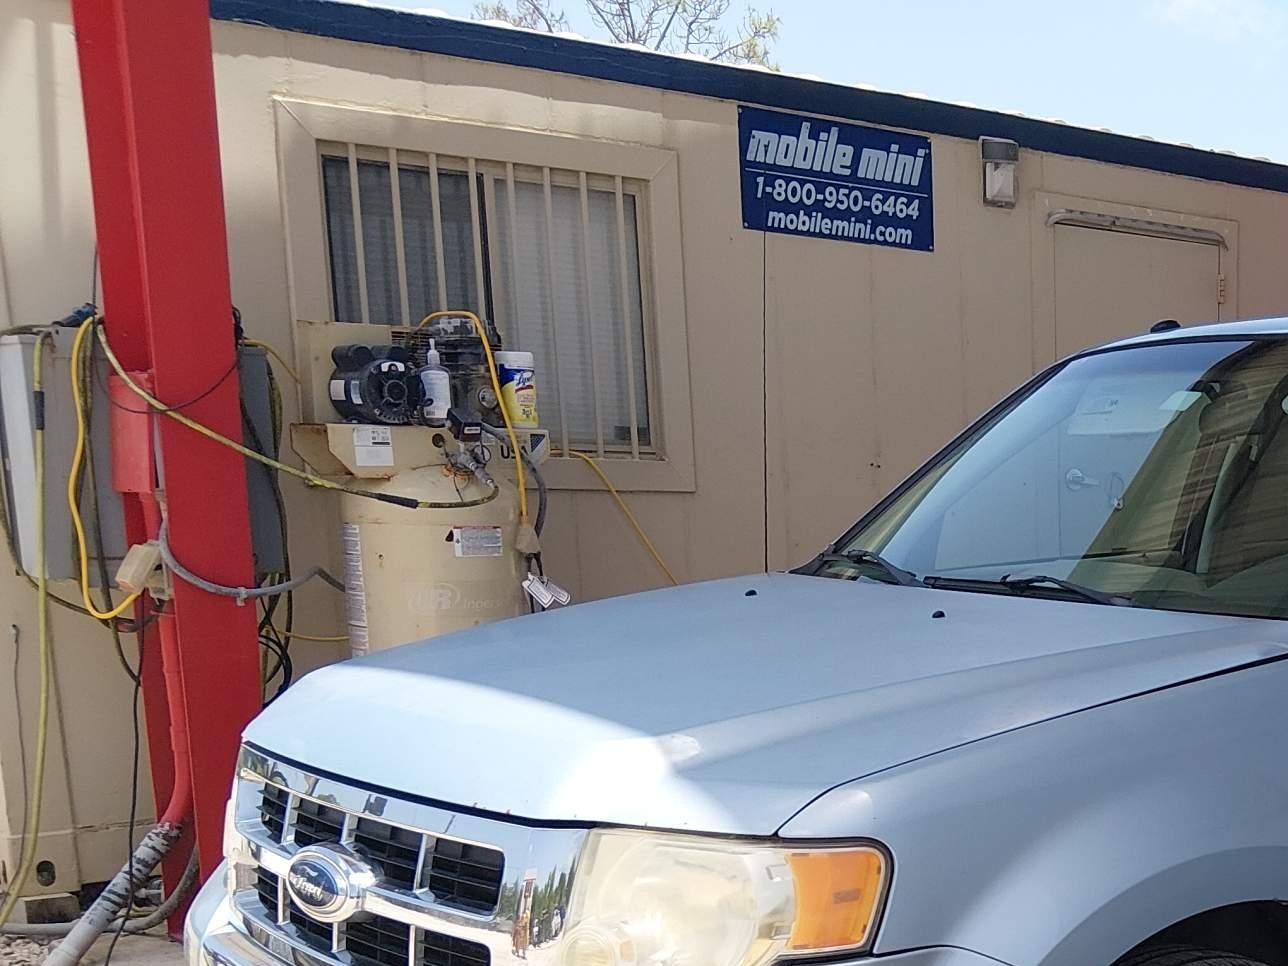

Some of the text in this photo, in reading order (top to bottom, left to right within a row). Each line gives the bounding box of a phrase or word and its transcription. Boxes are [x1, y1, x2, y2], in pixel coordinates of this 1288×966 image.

[746, 122, 926, 186] mobile mini
[756, 176, 920, 220] 1-800-950-6464
[767, 210, 913, 245] mobilemini.com
